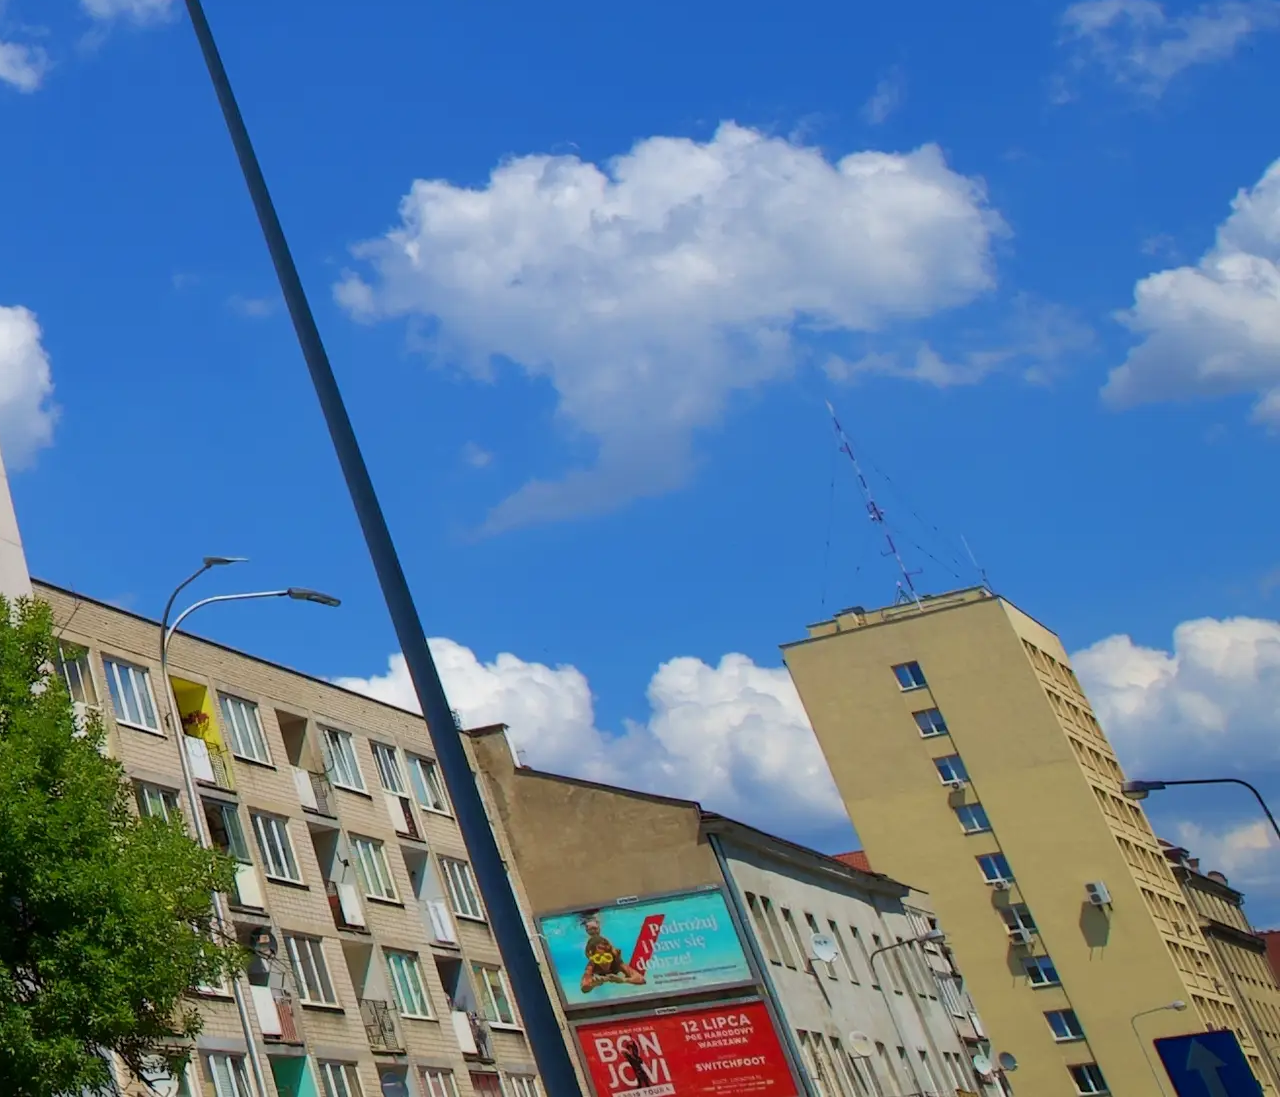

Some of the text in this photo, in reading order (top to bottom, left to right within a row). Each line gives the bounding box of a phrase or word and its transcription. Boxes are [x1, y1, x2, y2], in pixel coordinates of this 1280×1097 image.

[649, 938, 680, 953] baw
[684, 933, 706, 949] się
[636, 951, 692, 971] dobrze!
[681, 1014, 751, 1033] 12 LIPCA
[685, 1027, 754, 1042] PGE NARODOWY
[698, 1037, 749, 1049] WARSZAWA
[594, 1031, 664, 1063] BON
[608, 1057, 672, 1089] JOVI
[695, 1056, 766, 1072] SWITCHFOOT
